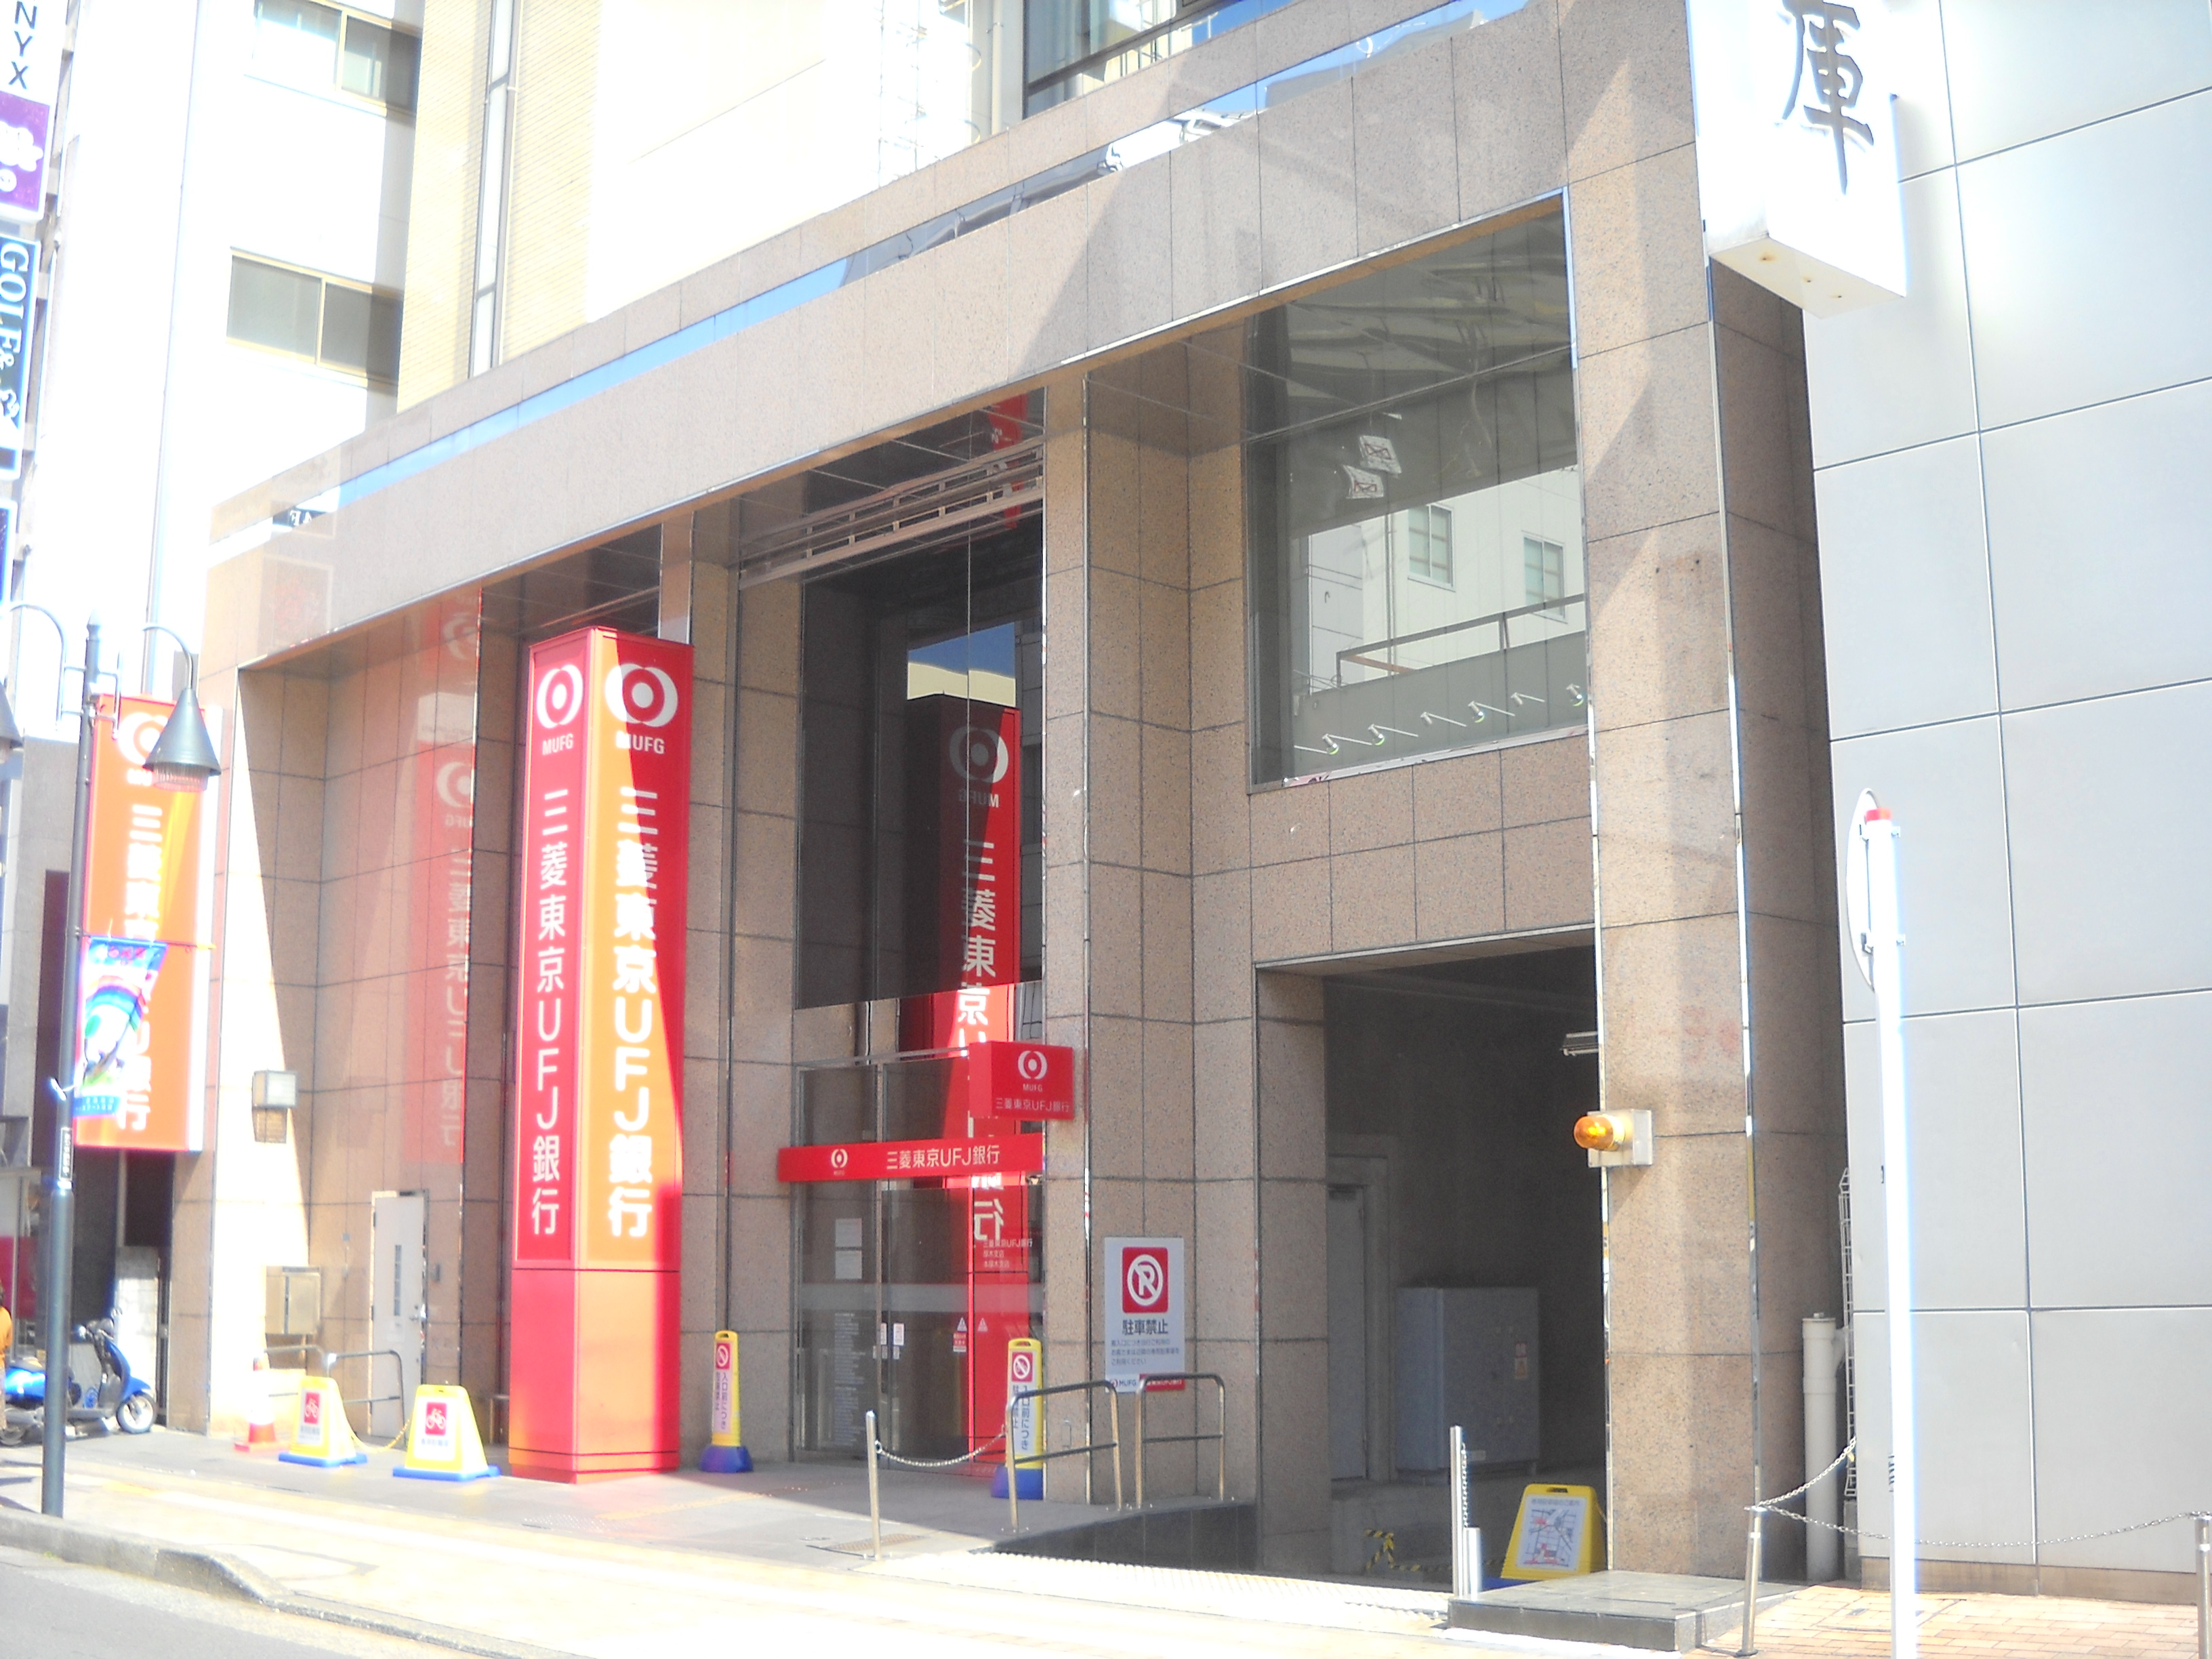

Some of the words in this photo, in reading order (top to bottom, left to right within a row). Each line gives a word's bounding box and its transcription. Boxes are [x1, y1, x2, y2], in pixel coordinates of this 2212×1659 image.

[543, 733, 574, 755] MUFG
[615, 731, 665, 755] MUFG
[531, 789, 569, 1235] 三菱東京UFJ銀行
[608, 786, 658, 1238] 三菱東京UFJ銀行
[1022, 1084, 1043, 1092] MUFG
[996, 1097, 1070, 1113] 三菱東京UFJ銀行
[886, 1145, 1000, 1170] 三菱東京UFJ銀行
[1122, 1319, 1169, 1336] 駐車禁止
